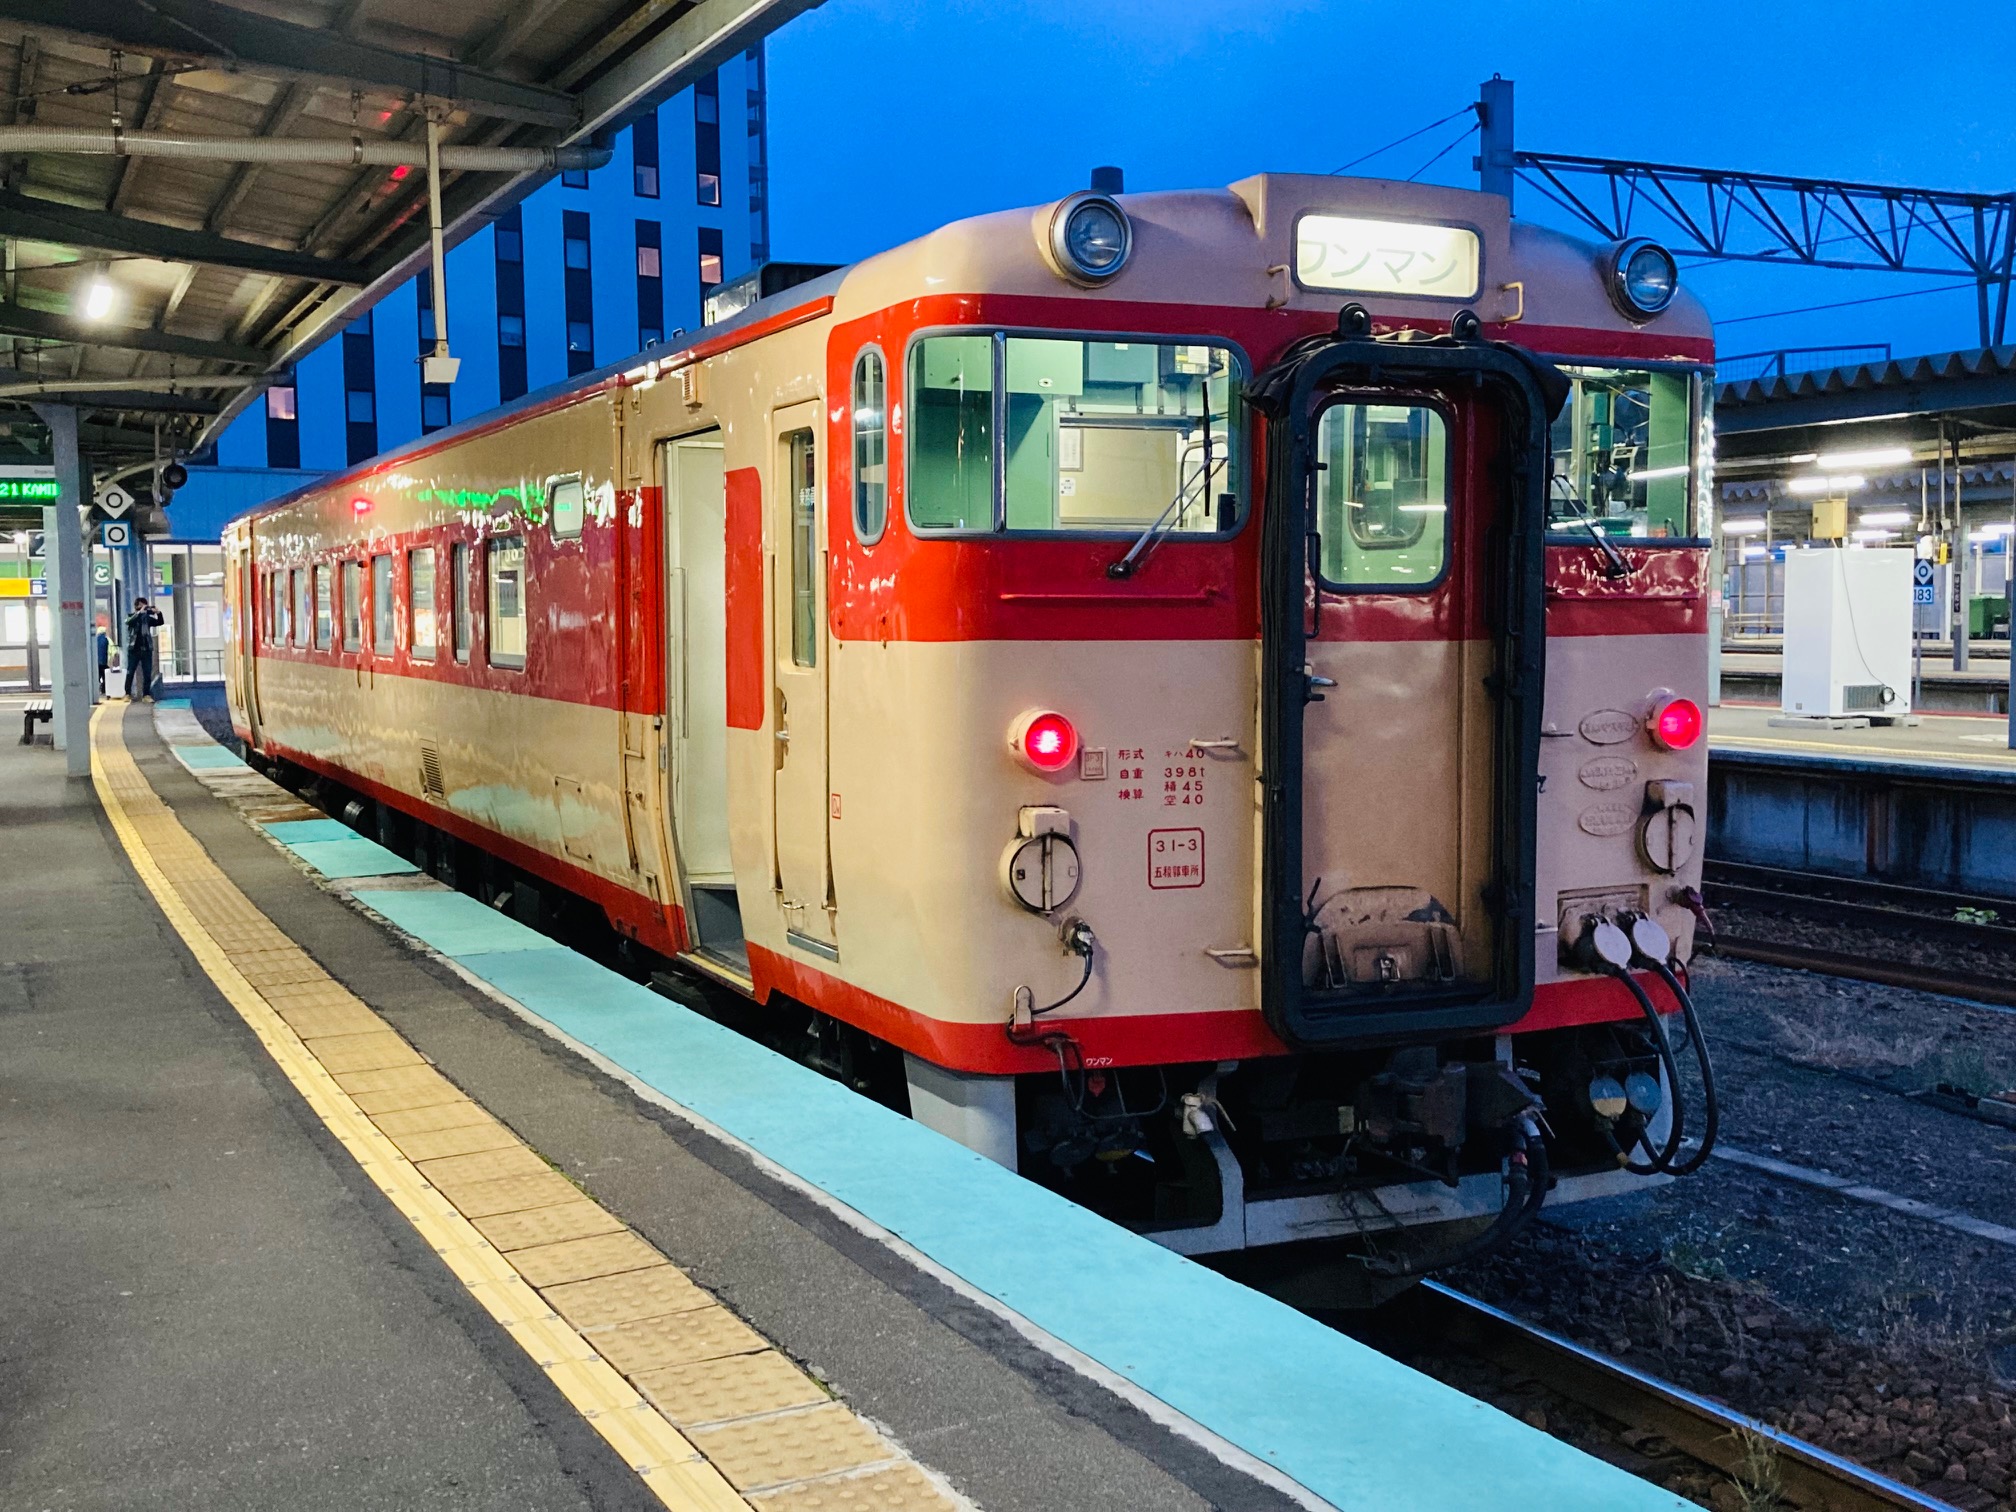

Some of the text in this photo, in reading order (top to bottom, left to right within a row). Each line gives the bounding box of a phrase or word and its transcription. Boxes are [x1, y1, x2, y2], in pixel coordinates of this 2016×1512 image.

[1299, 239, 1458, 286] ワンマン
[1914, 588, 1932, 601] 183
[1118, 748, 1145, 760] 形式
[1119, 767, 1144, 780] 自重
[1156, 838, 1198, 853] 31-3
[1085, 1057, 1113, 1066] ワンマン
